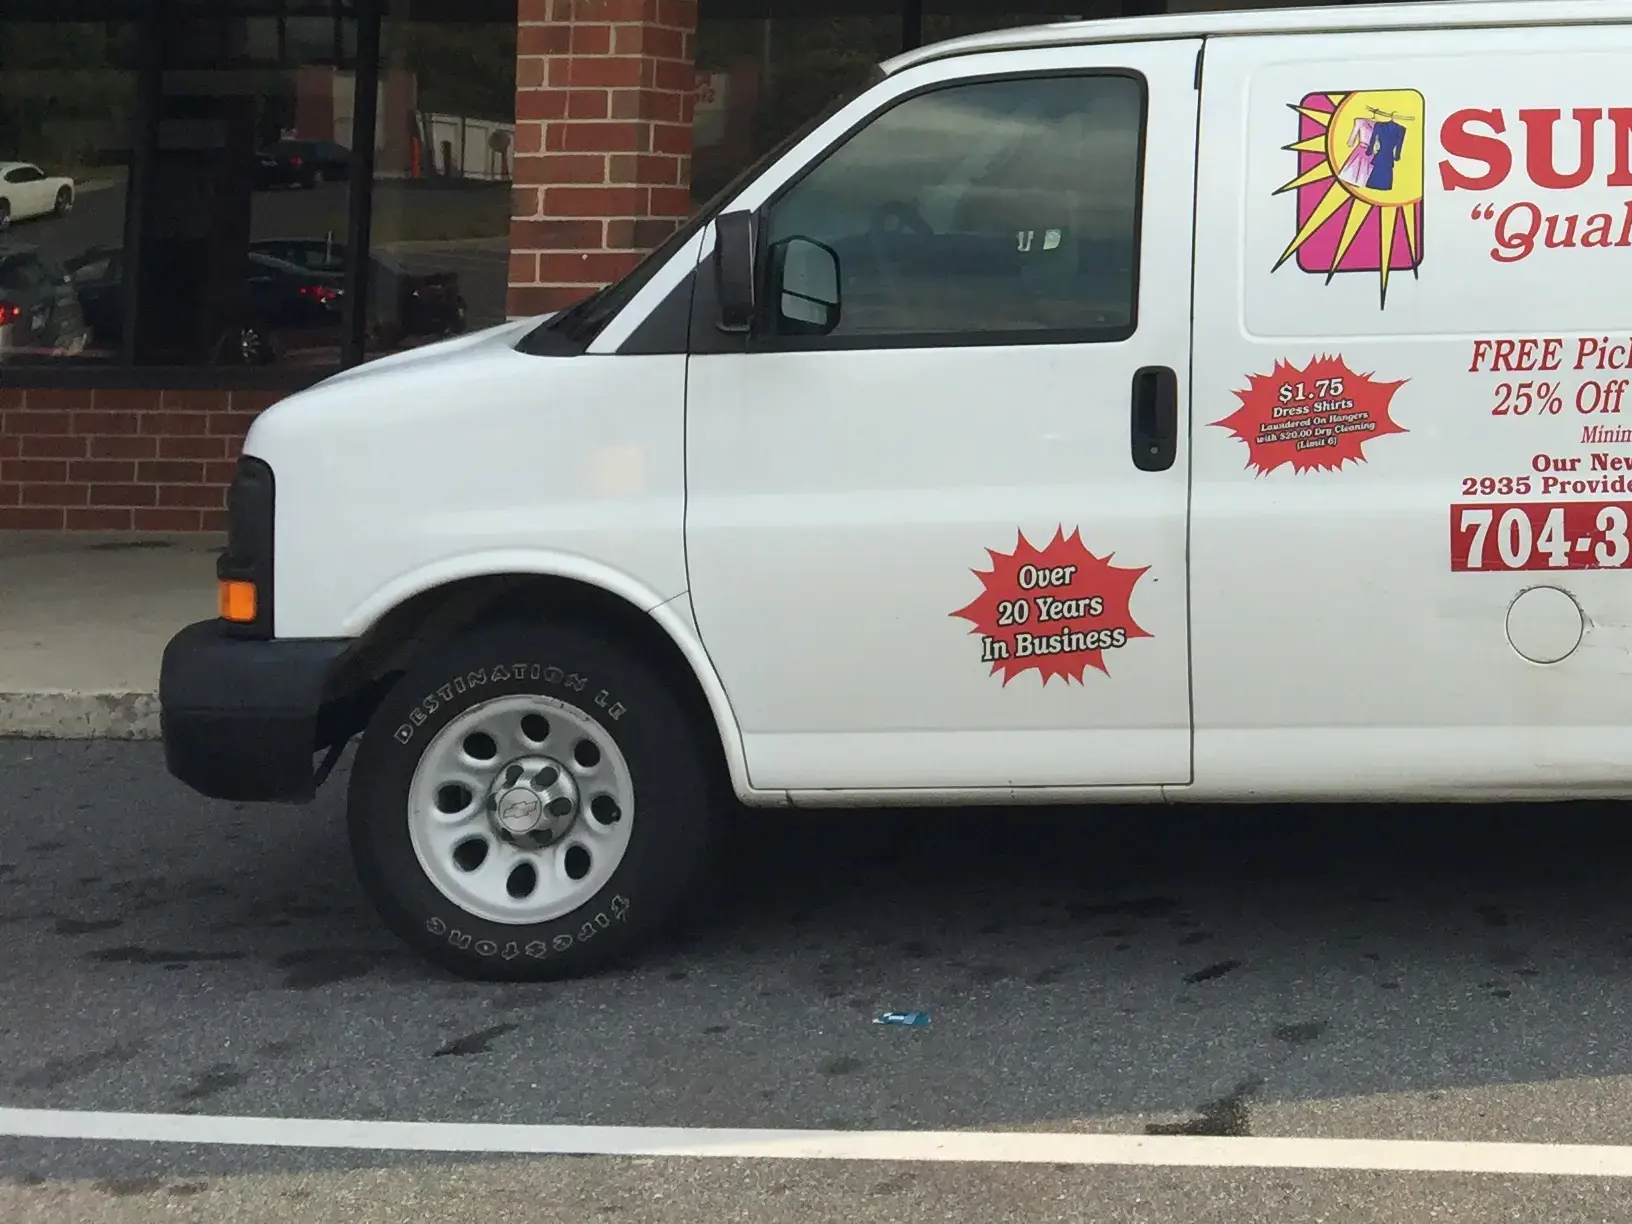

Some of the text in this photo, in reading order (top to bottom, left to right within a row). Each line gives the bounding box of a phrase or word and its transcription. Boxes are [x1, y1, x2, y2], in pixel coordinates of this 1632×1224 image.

[1468, 338, 1563, 373] FREE
[1279, 376, 1344, 404] $1.75
[1491, 380, 1563, 416] 25%
[1575, 379, 1630, 414] Off
[1260, 411, 1369, 432] Laundered On Hangers
[1272, 399, 1353, 419] Dress Shirts
[1256, 421, 1375, 444] with $20.00 Dry Cleaning
[1296, 438, 1325, 451] (Limit
[1531, 453, 1581, 472] Our
[1462, 476, 1532, 496] 2935
[1018, 564, 1076, 590] Over
[997, 596, 1104, 627] 20 Years
[981, 626, 1128, 662] In Business
[394, 663, 629, 746] DESTINATION LE
